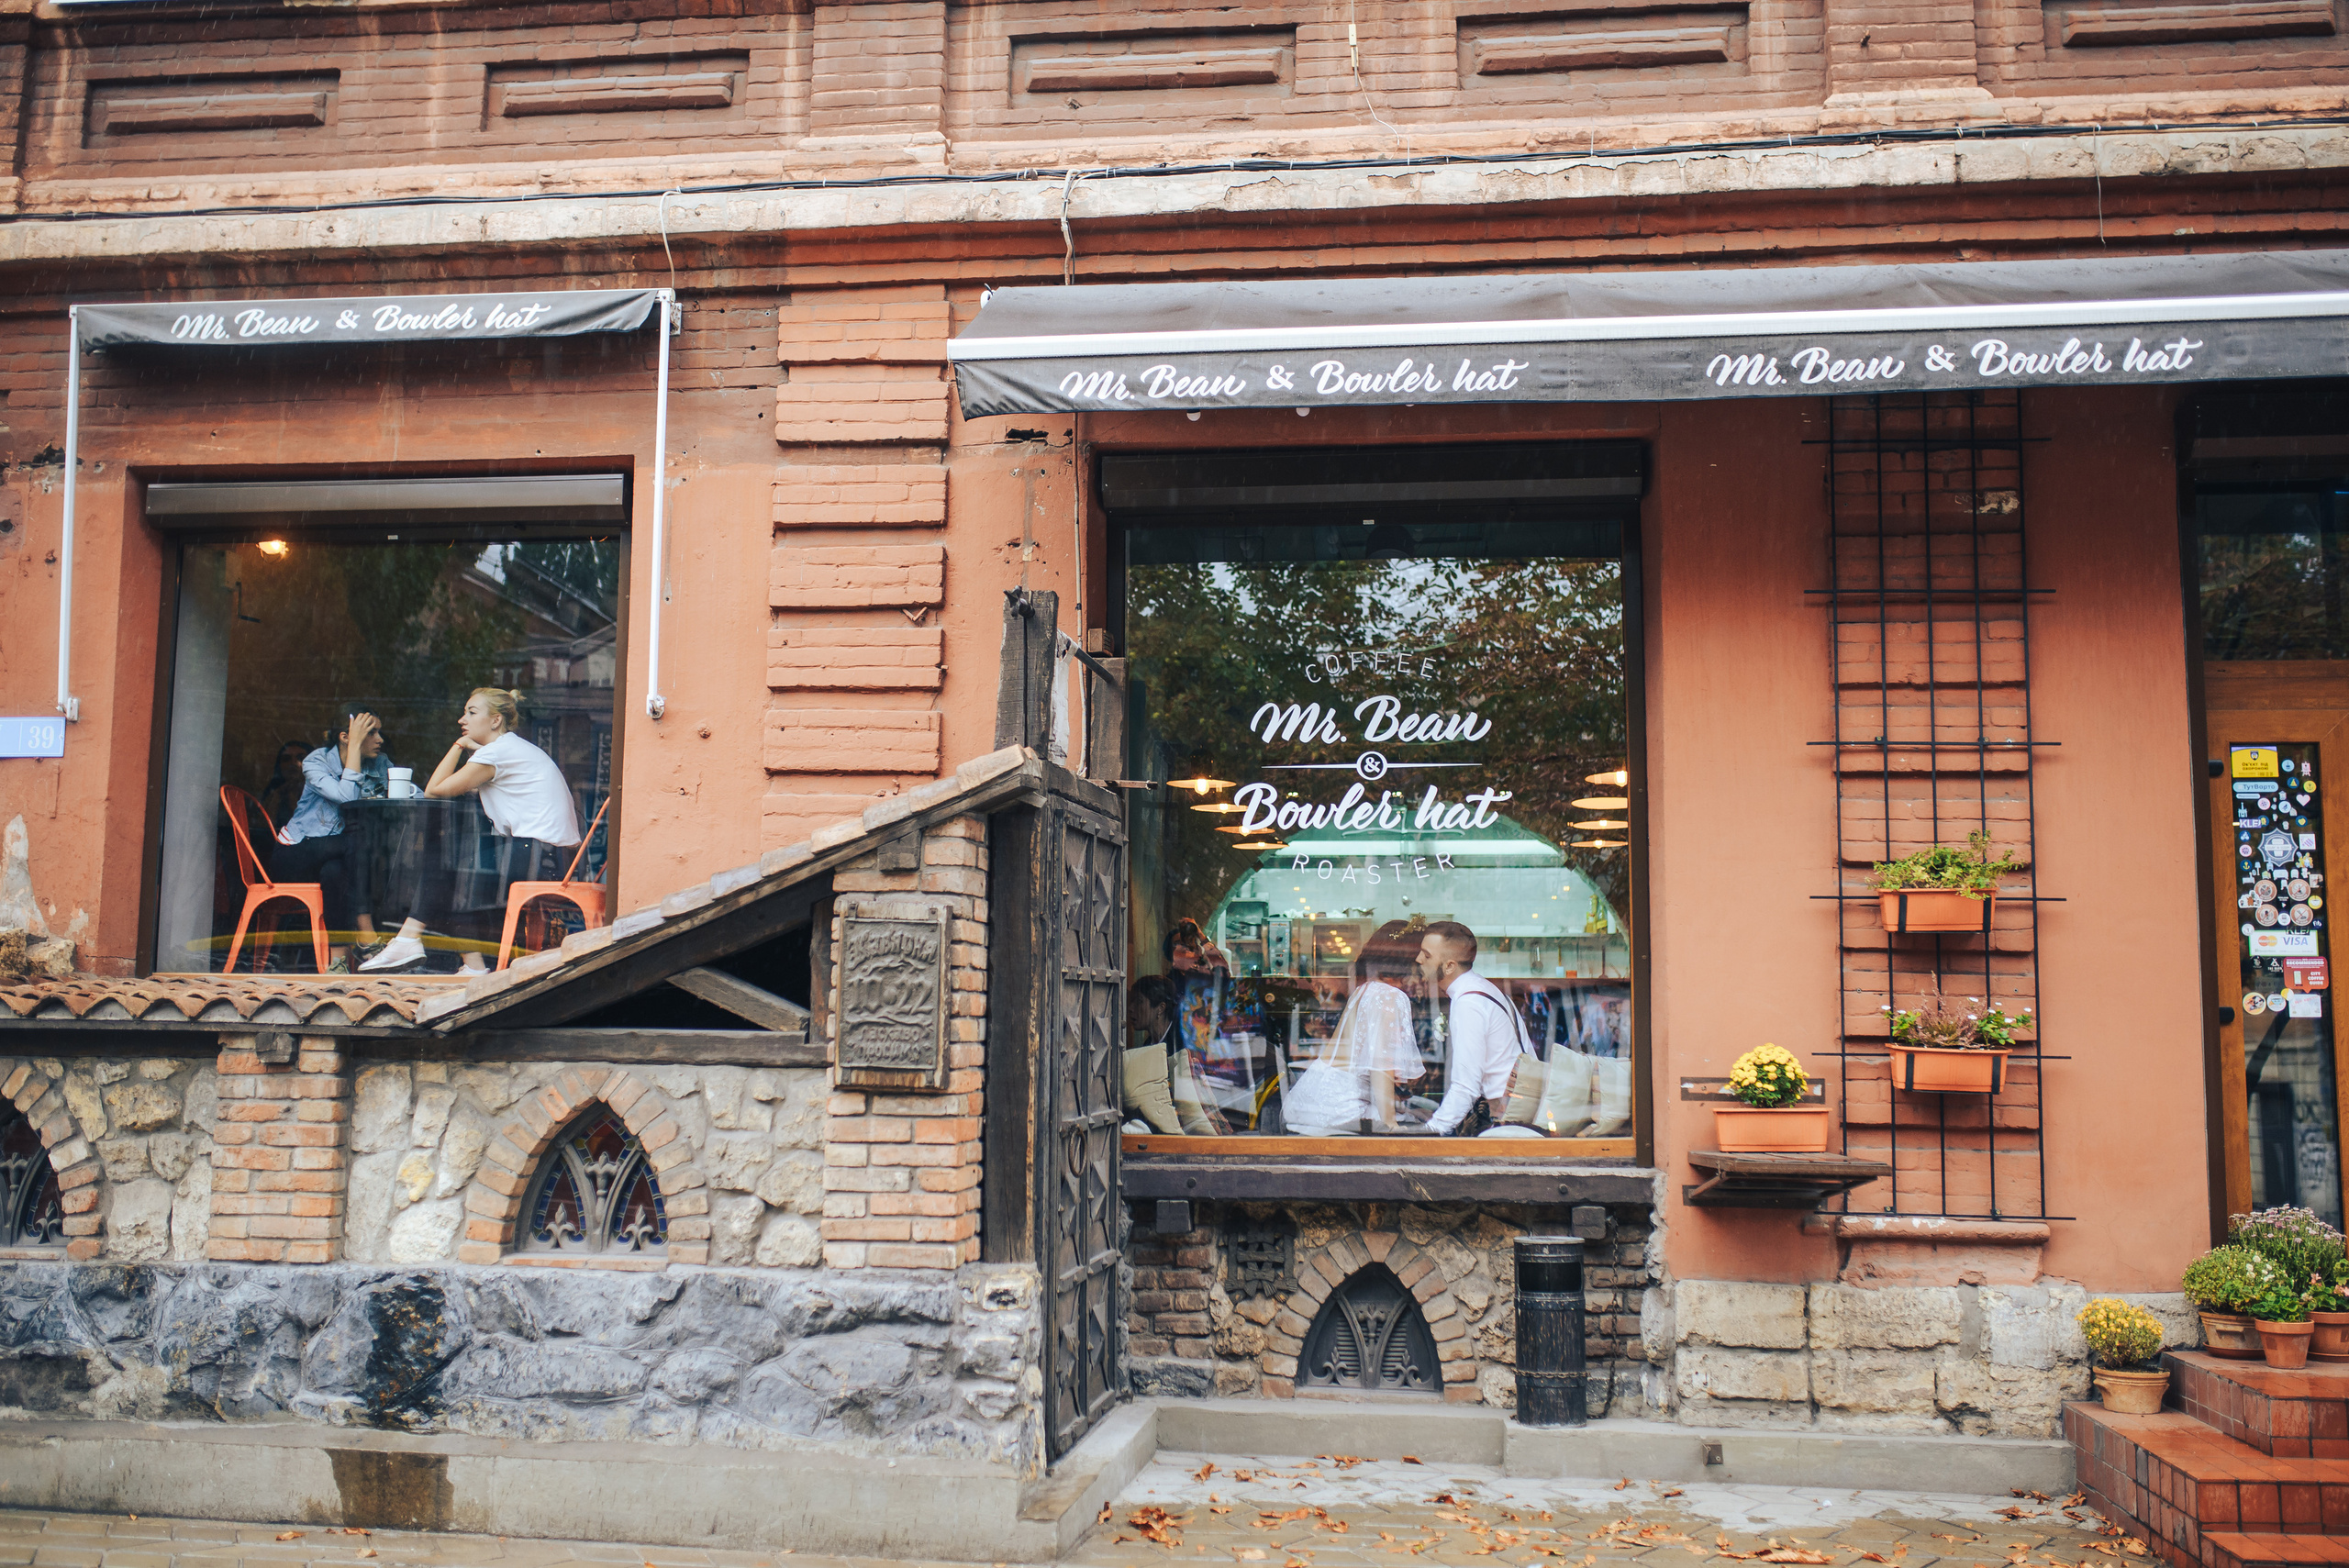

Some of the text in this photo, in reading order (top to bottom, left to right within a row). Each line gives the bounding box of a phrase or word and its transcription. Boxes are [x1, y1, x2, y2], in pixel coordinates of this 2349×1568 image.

[171, 301, 551, 340] Mr. Bean & Bowler hat
[1059, 358, 1530, 401] Mr. Bean & Bowler hat
[1706, 337, 2204, 386] Mr. Bean & Bowler hat
[1305, 651, 1438, 684] COFFEE
[28, 725, 55, 750] 39
[1250, 695, 1492, 744] Mr. Bean
[1233, 782, 1513, 830] Bowler hat
[1292, 851, 1455, 885] ROASTER
[2283, 937, 2308, 945] VISA
